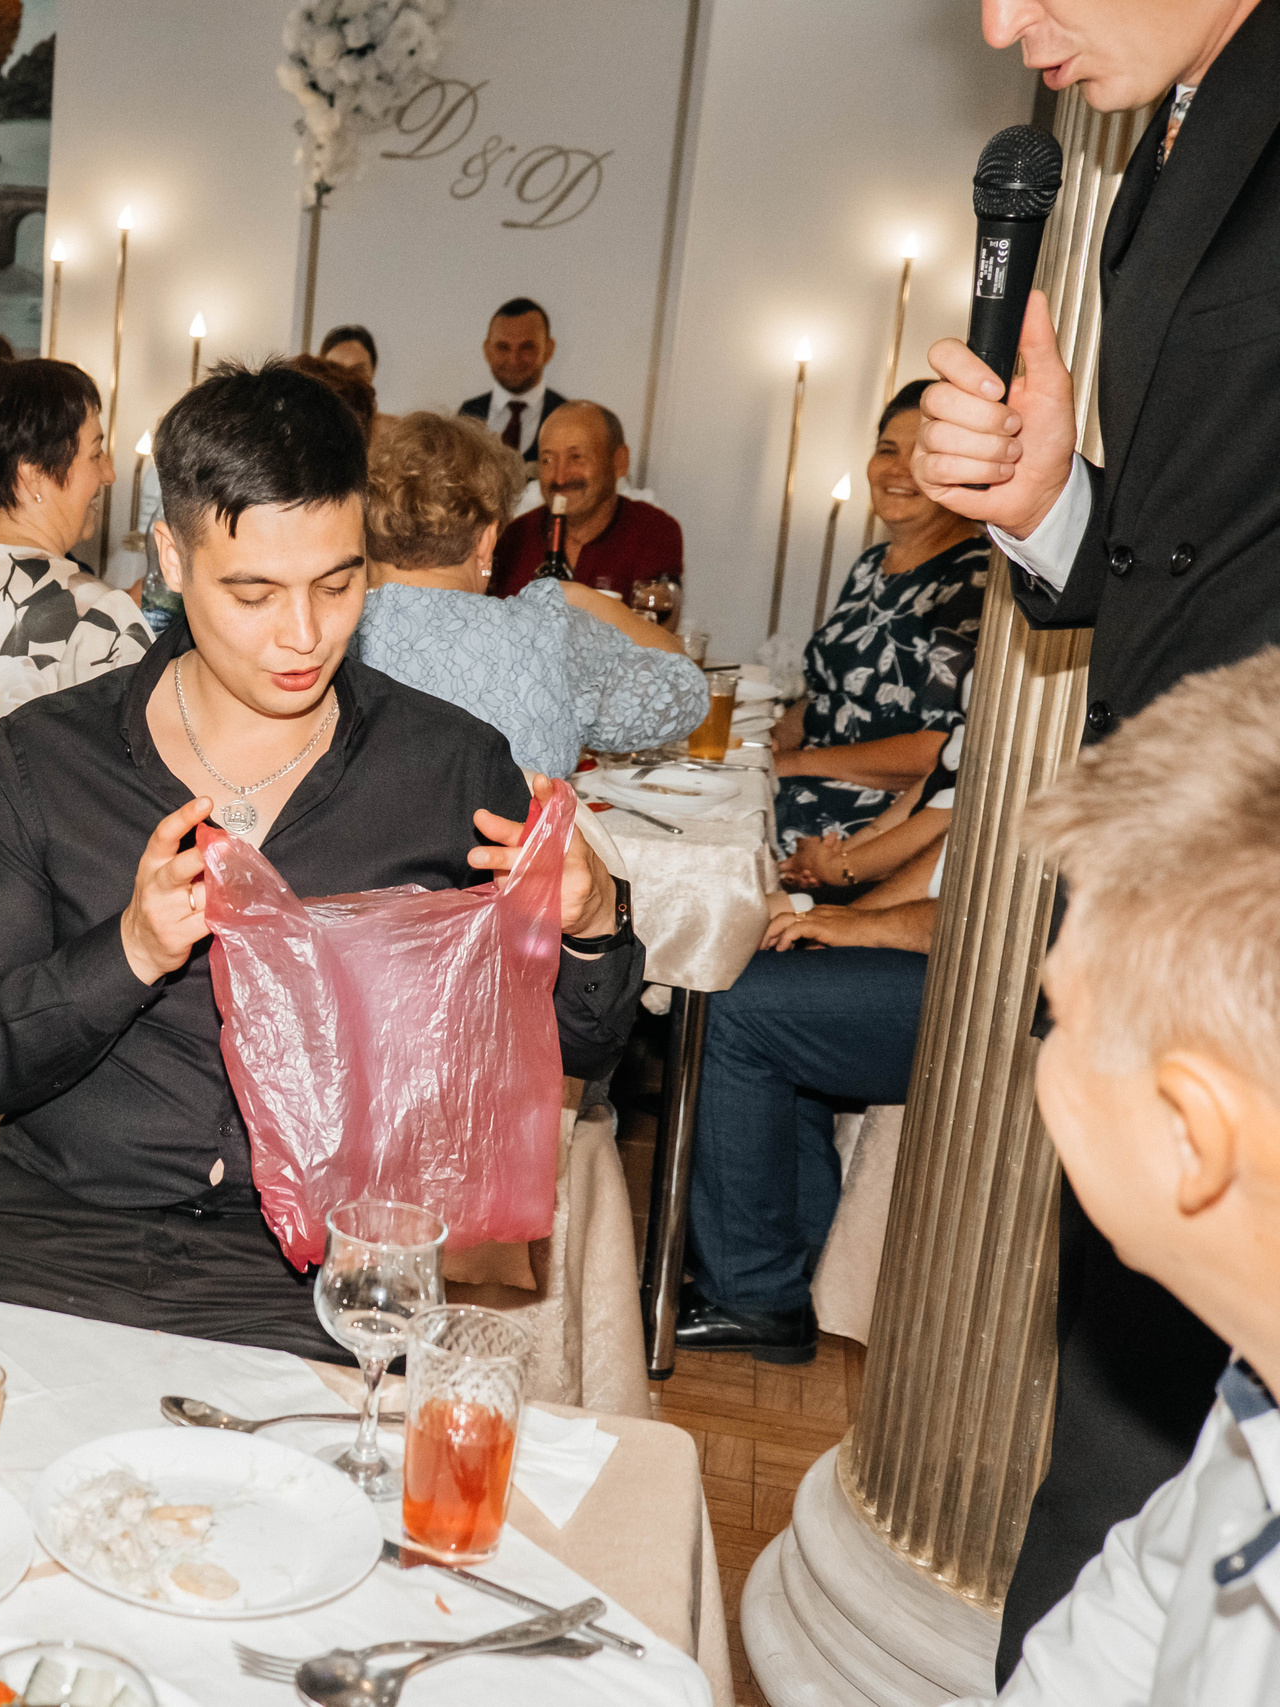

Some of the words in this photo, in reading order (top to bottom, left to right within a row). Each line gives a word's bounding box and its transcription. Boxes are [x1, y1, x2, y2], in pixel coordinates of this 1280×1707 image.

[380, 72, 490, 160] D
[449, 135, 516, 199] &
[501, 145, 615, 230] D
